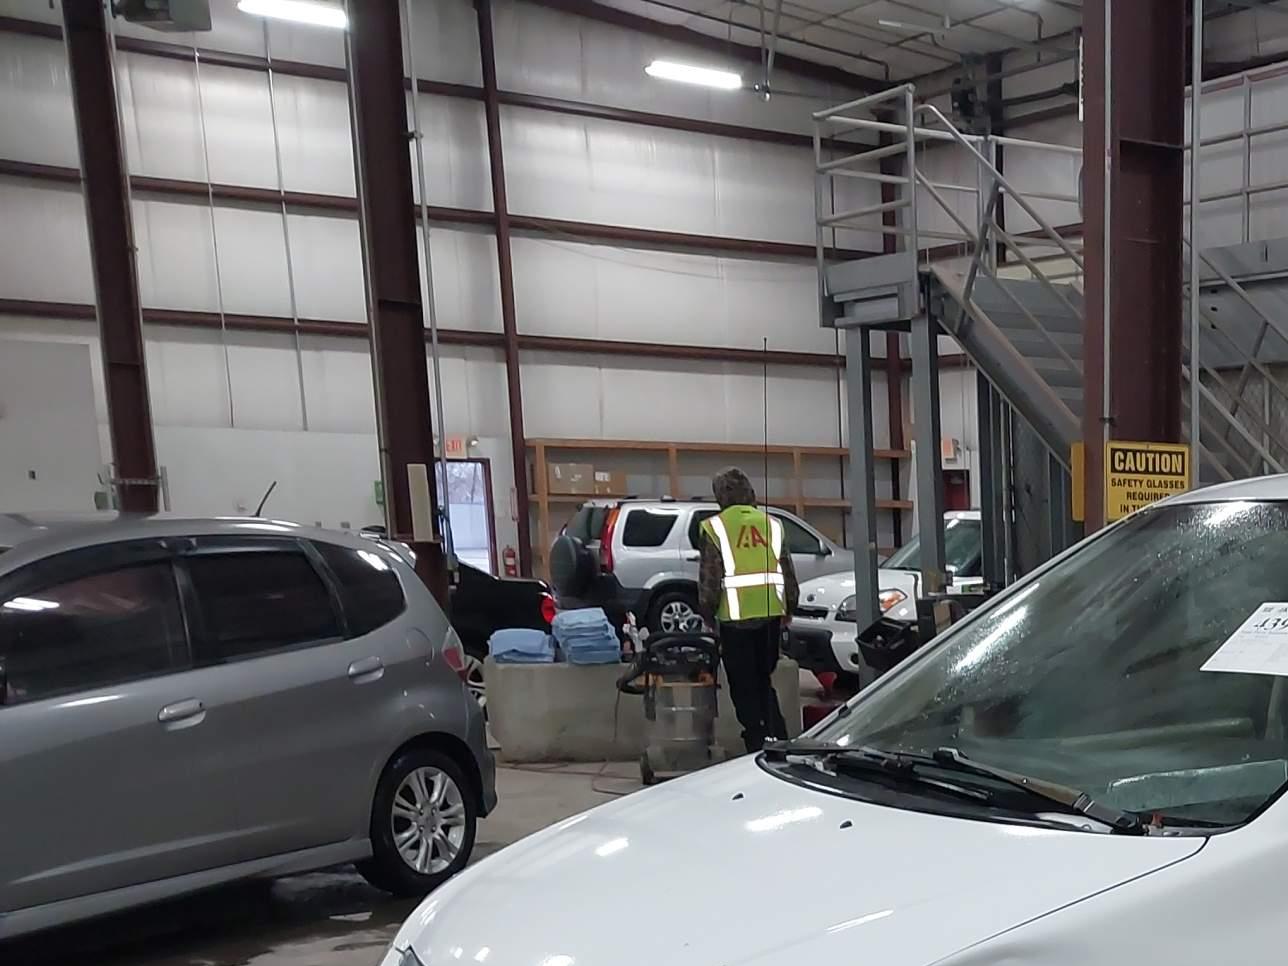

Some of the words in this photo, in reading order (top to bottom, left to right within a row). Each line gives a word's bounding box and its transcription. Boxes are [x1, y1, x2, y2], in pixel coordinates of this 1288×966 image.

[1114, 451, 1182, 473] CAUTION
[1111, 478, 1144, 488] SAFETY
[1146, 479, 1185, 489] GLASSES
[1120, 503, 1130, 513] IN
